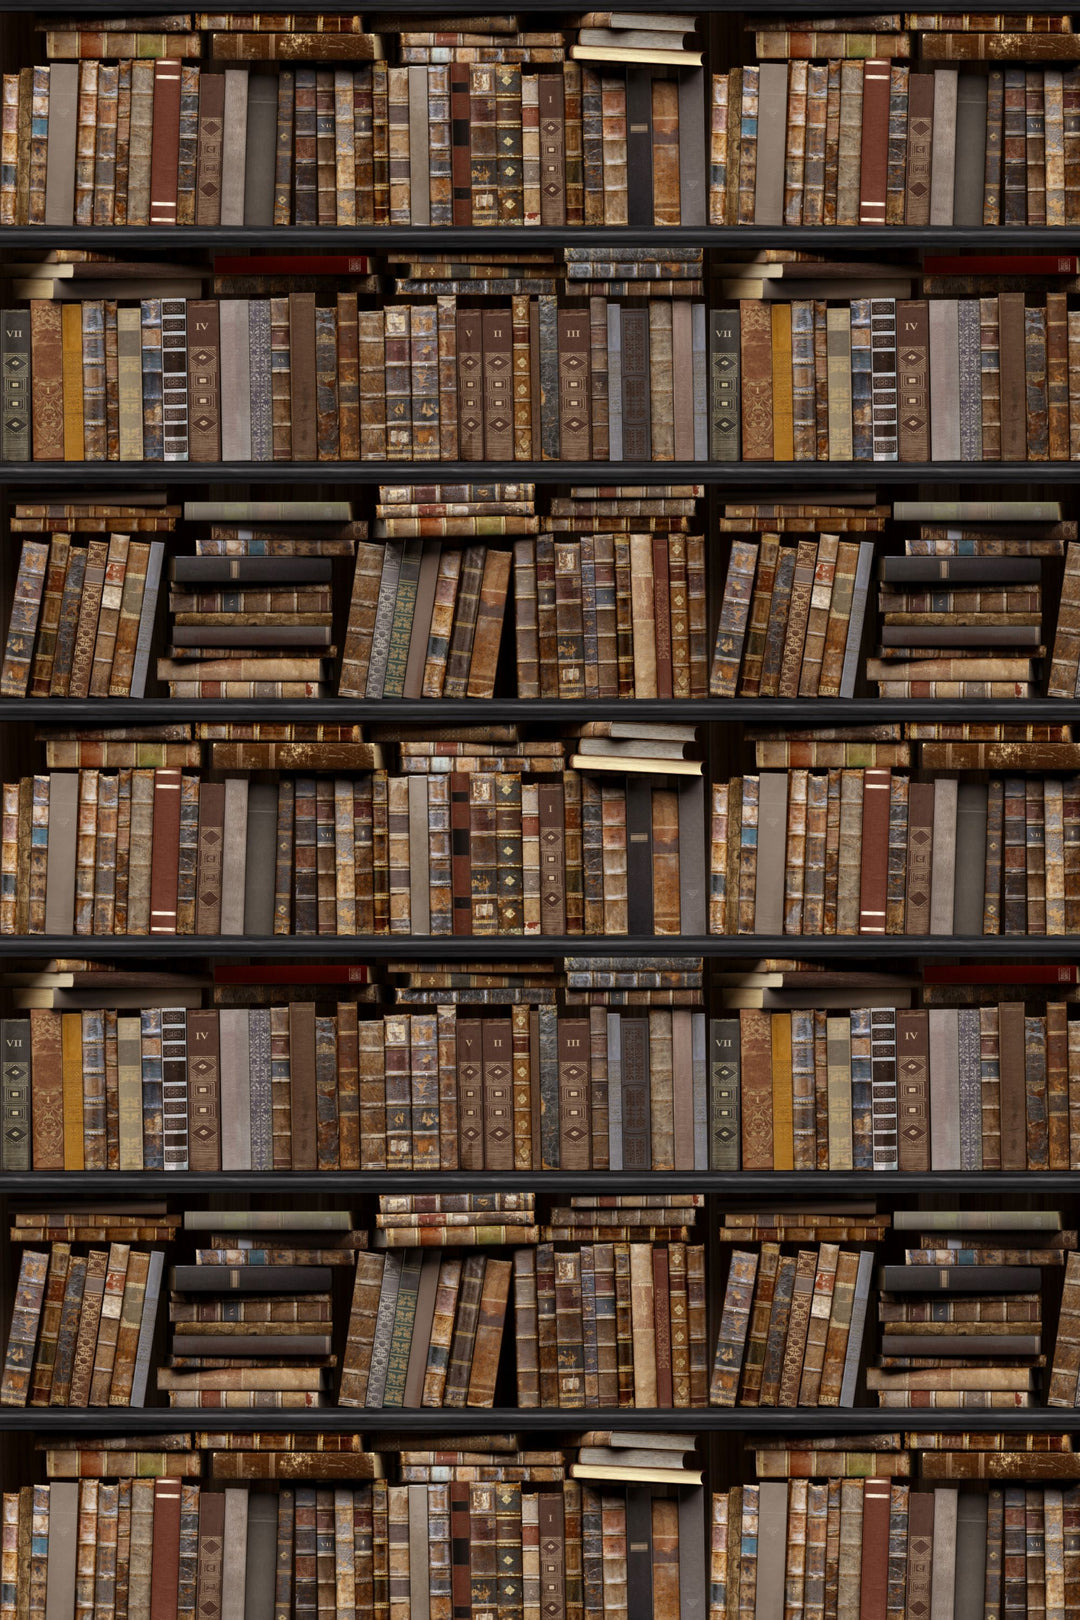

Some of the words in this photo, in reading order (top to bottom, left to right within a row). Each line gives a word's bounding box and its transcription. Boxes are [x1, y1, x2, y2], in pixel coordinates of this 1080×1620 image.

[548, 95, 553, 104] I
[196, 322, 209, 331] IV
[905, 322, 918, 331] IV
[6, 329, 23, 338] VII
[465, 329, 473, 337] V
[493, 329, 502, 338] II
[567, 329, 580, 338] III
[715, 329, 732, 338] VII
[548, 804, 553, 813] I
[196, 1031, 209, 1040] IV
[905, 1031, 918, 1040] IV
[6, 1038, 23, 1047] VII
[465, 1038, 473, 1046] V
[493, 1038, 502, 1047] II
[567, 1038, 580, 1047] III
[715, 1038, 732, 1047] VII
[548, 1514, 553, 1523] I
